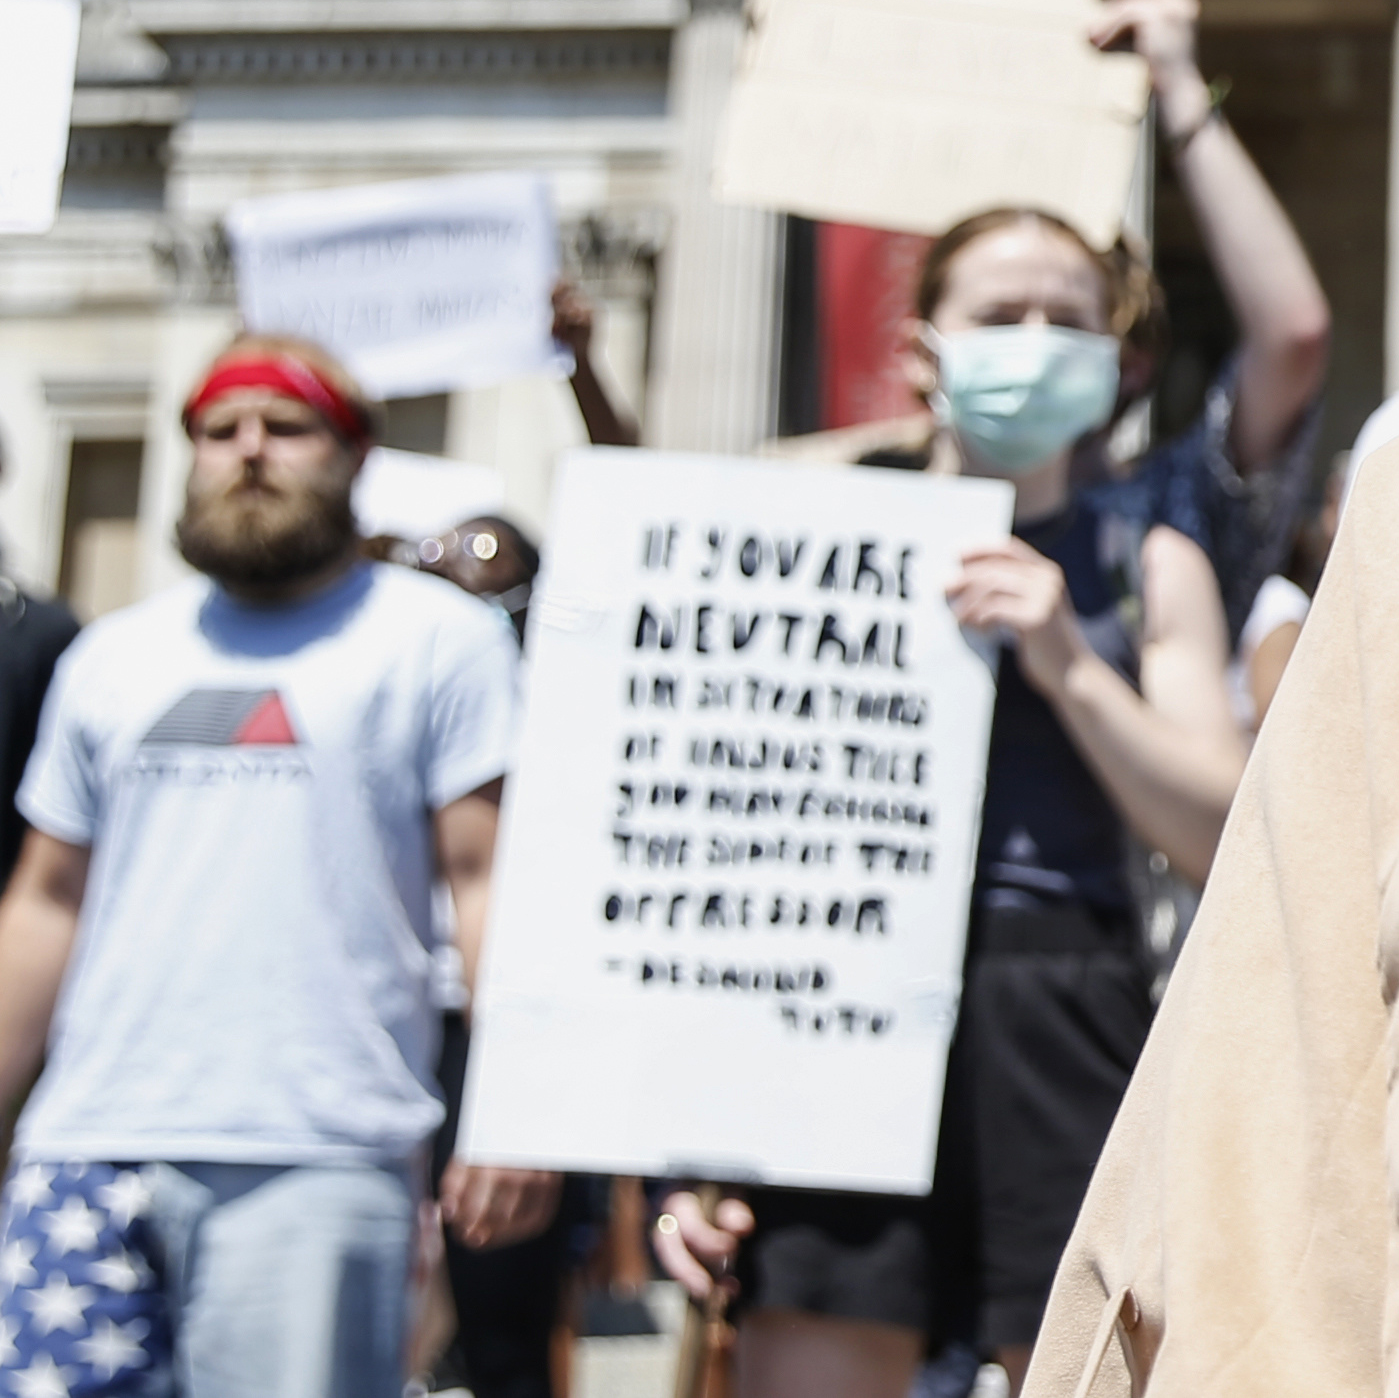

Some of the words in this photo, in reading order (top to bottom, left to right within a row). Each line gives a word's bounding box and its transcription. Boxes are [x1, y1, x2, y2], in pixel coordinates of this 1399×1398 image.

[643, 523, 680, 569] IF
[699, 528, 805, 580] YOU
[816, 539, 914, 601] ARE
[632, 603, 911, 669] NEUTRAL
